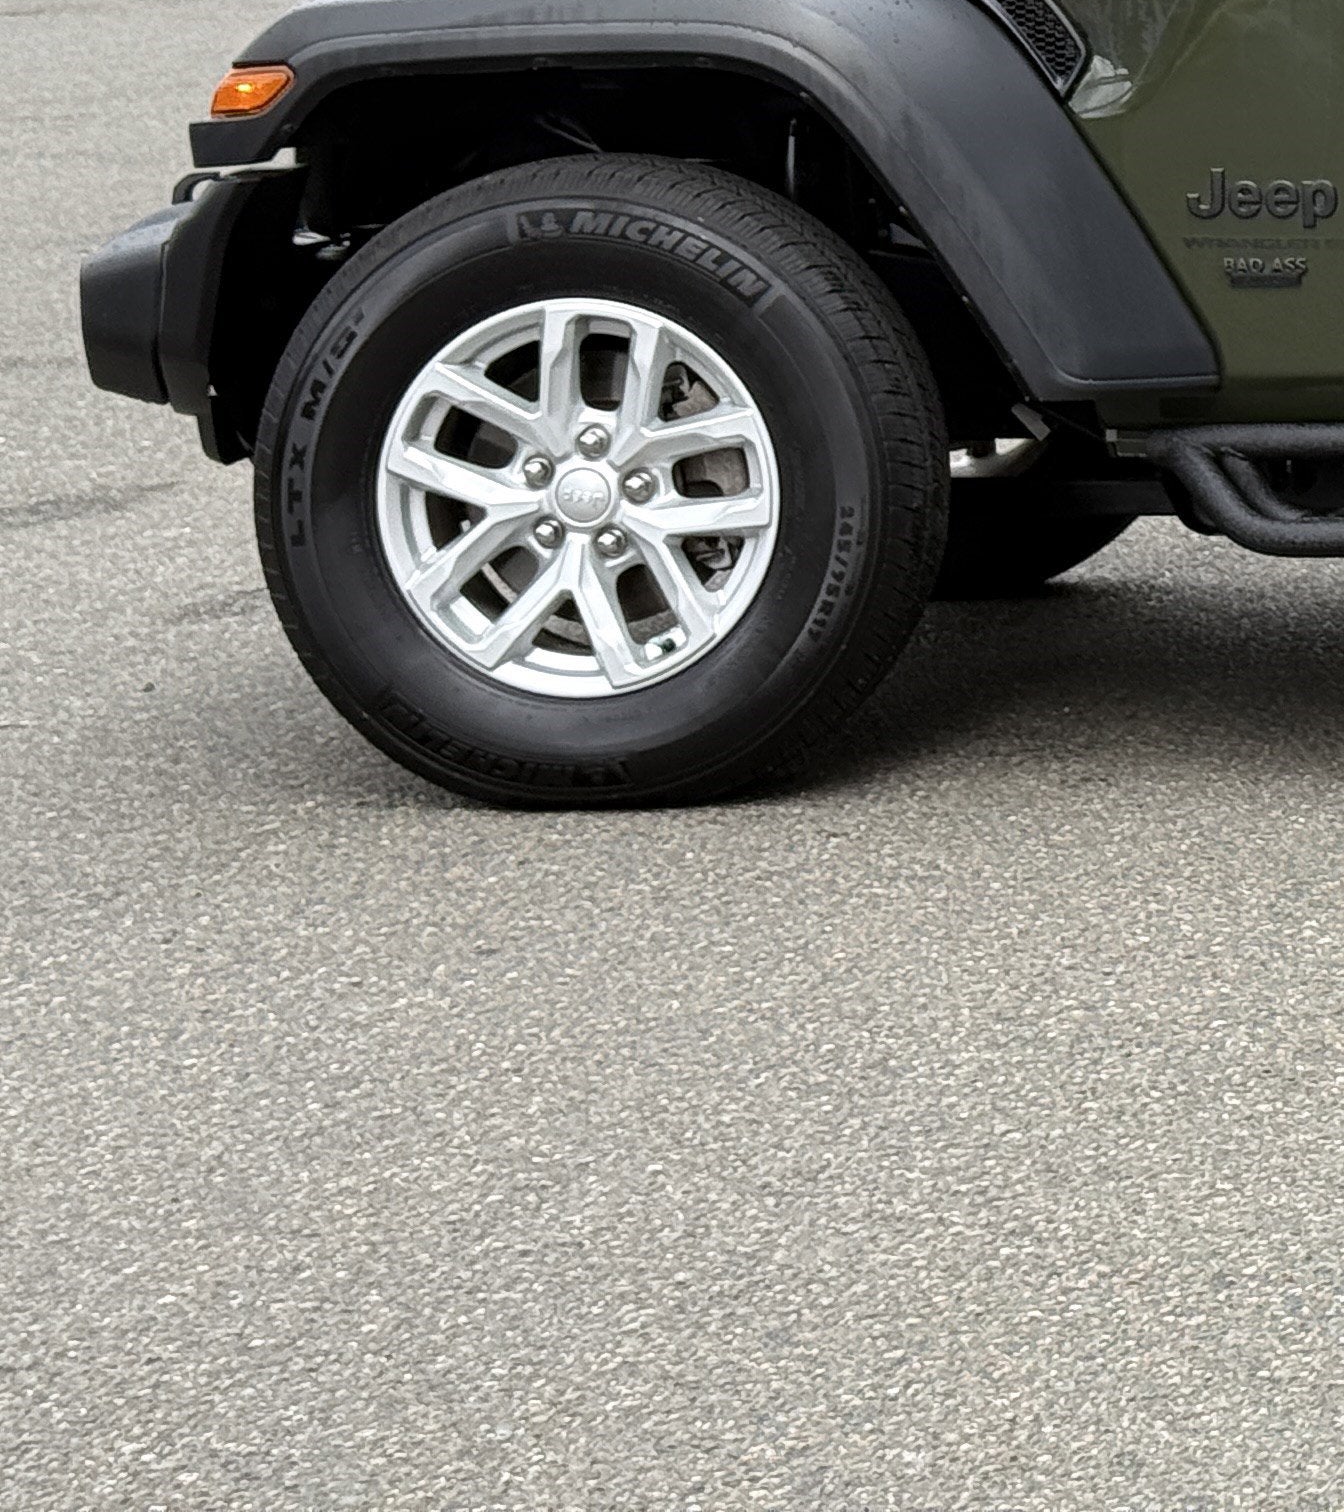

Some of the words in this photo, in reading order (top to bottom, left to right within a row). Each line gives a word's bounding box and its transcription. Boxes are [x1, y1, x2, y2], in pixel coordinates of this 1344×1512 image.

[1186, 167, 1339, 229] Jeep
[568, 210, 767, 298] MICHELIN
[1223, 256, 1265, 275] BAD
[1271, 256, 1309, 275] ASS
[286, 443, 308, 547] LTX
